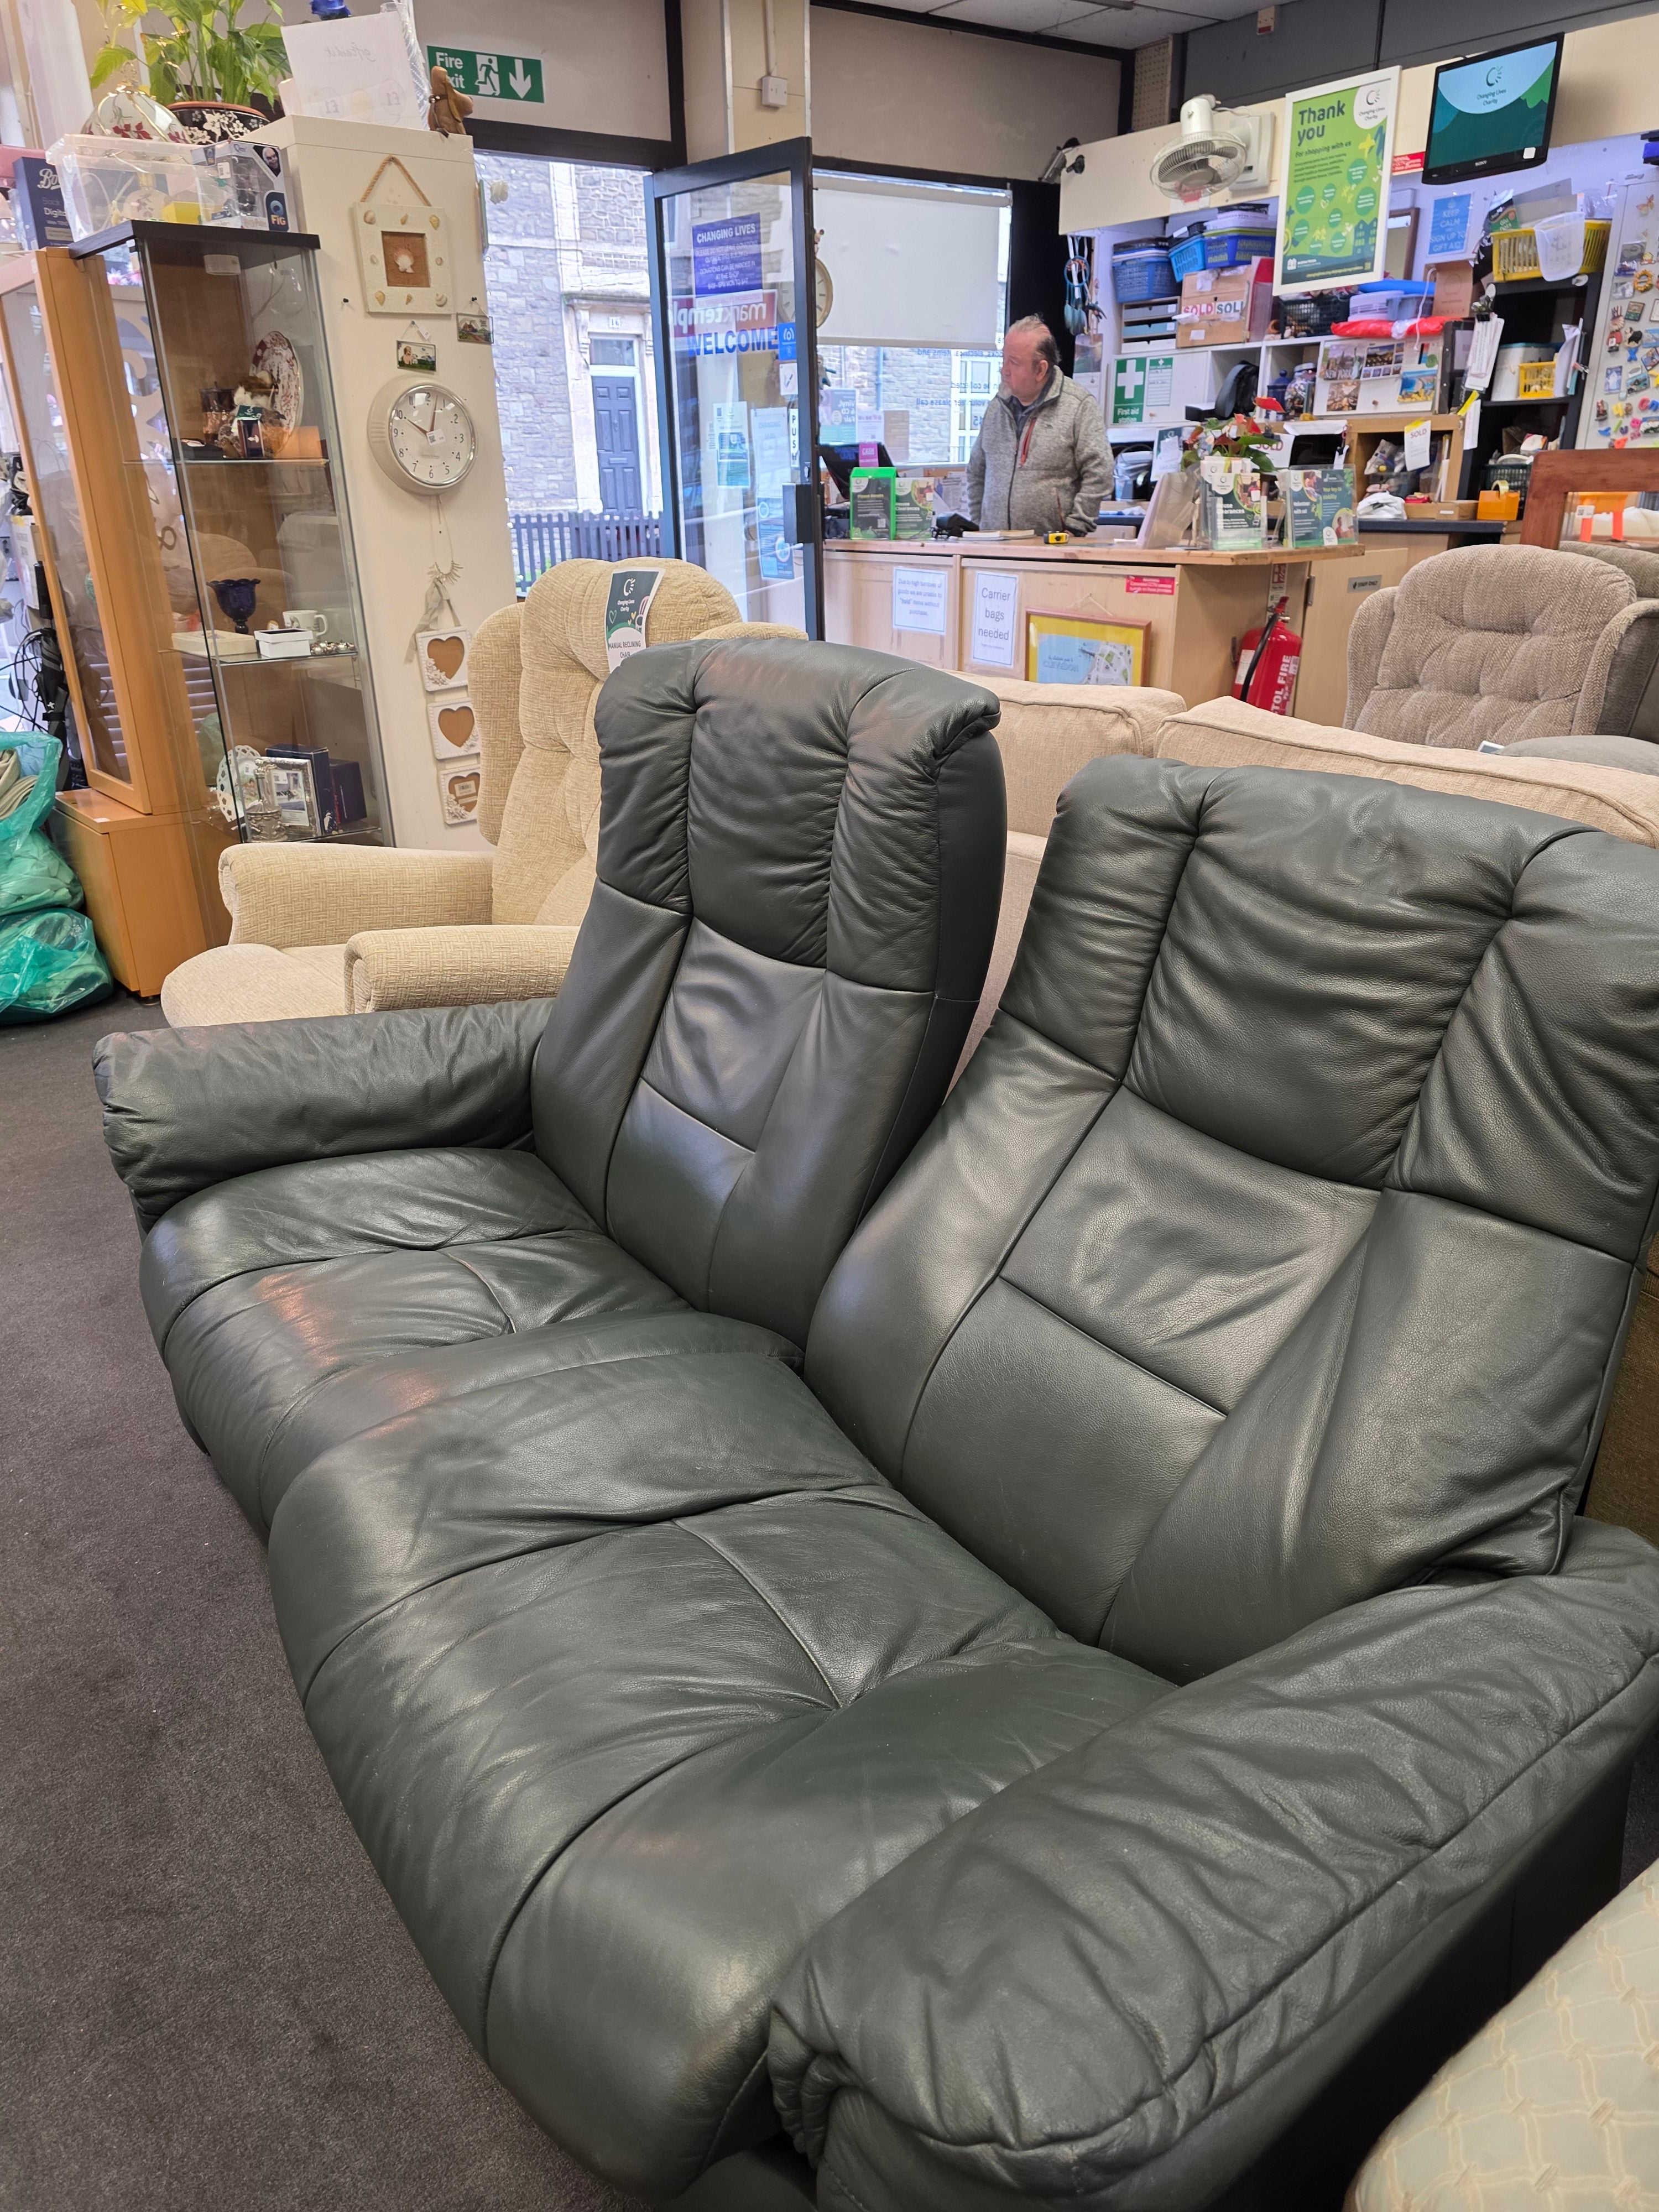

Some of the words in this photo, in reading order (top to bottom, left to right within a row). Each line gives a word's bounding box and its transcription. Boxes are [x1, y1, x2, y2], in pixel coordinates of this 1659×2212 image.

[435, 51, 463, 69] Fire
[445, 74, 466, 88] xit
[1477, 91, 1495, 100] Changing
[1298, 100, 1346, 126] Thank
[1297, 124, 1326, 147] you
[1305, 145, 1330, 156] shopping
[1331, 141, 1344, 149] with
[697, 227, 734, 244] CHANGING
[734, 223, 756, 237] LIVES
[1183, 302, 1213, 316] SOLD
[686, 326, 779, 357] WELCOME
[453, 413, 459, 424] 2
[1118, 416, 1137, 425] station
[393, 428, 398, 437] 9
[460, 433, 464, 443] 3
[399, 448, 404, 458] 8
[455, 452, 461, 462] 4
[412, 462, 417, 472] 7
[429, 469, 434, 478] 6
[445, 465, 450, 475] 5
[982, 587, 1011, 601] Carrier
[984, 607, 1005, 622] bags
[978, 627, 1009, 641] needed
[609, 640, 623, 649] MANUAL
[623, 640, 641, 649] RECLINING
[1277, 655, 1291, 685] FIRE
[1271, 686, 1285, 714] TOL
